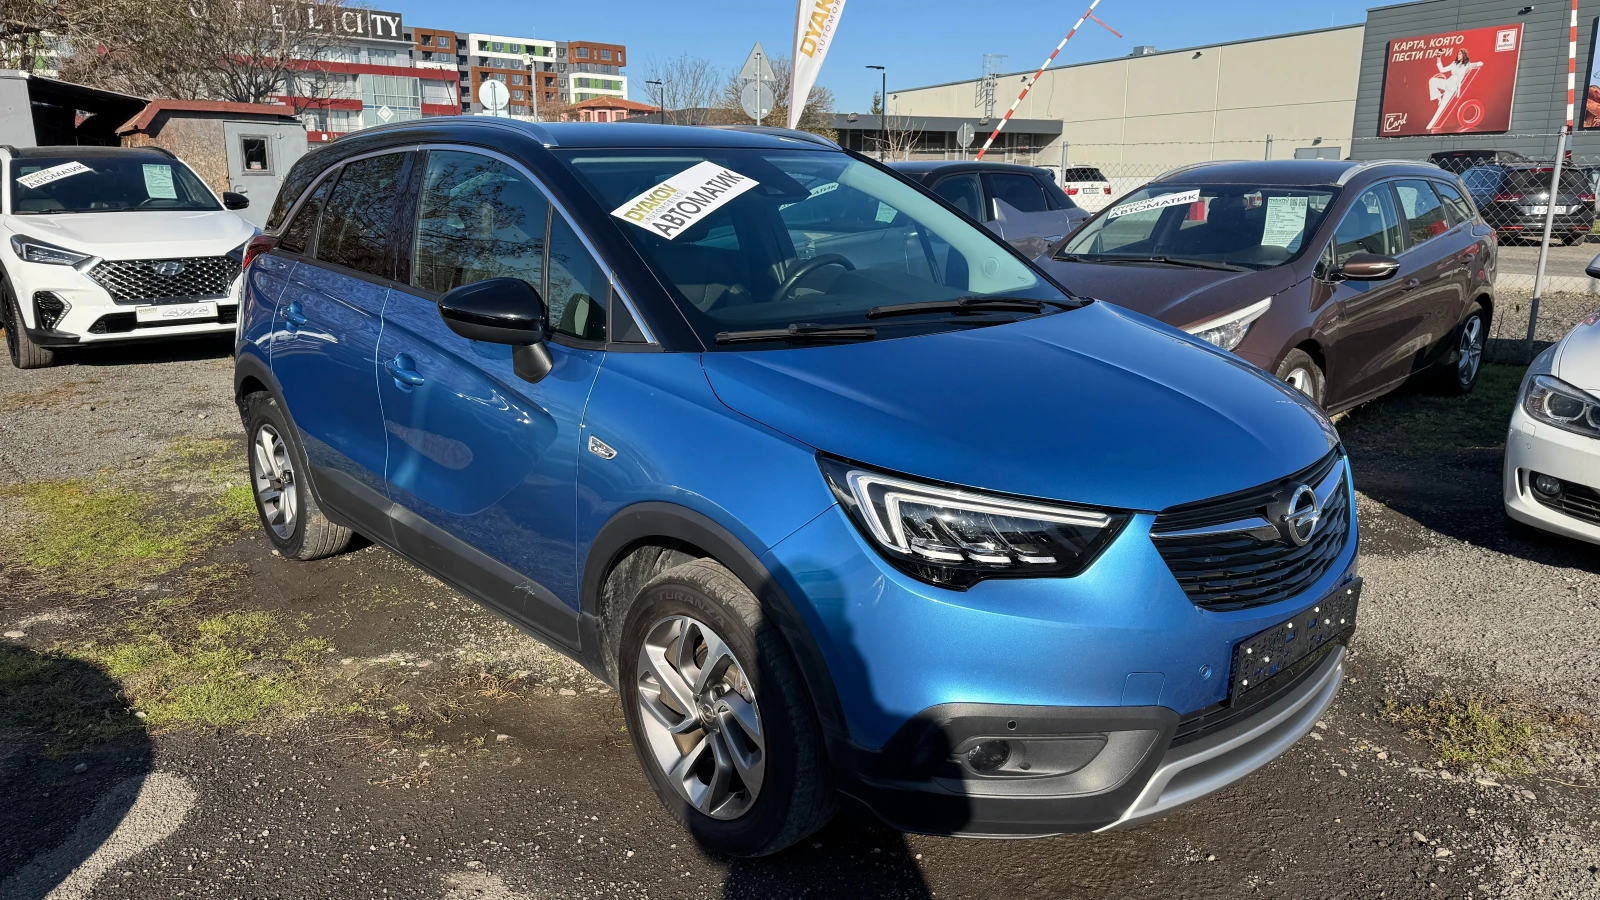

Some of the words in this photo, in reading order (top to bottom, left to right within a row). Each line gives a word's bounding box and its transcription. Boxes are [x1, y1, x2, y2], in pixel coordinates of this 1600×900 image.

[341, 11, 400, 36] CITY
[1392, 50, 1424, 62] ПЕСТИ
[1425, 47, 1454, 59] ПАРИ
[1393, 40, 1427, 52] КАРТА,
[1429, 35, 1464, 48] КОЯТО
[1386, 112, 1408, 130] Card
[623, 183, 678, 222] DYAKOV
[645, 191, 684, 222] AUTOMOBILES
[652, 170, 745, 237] АВТОМАТИК
[1110, 193, 1197, 217] АВТОМАТИК
[1112, 198, 1155, 212] DYAKOV
[657, 591, 726, 628] TURANZA
